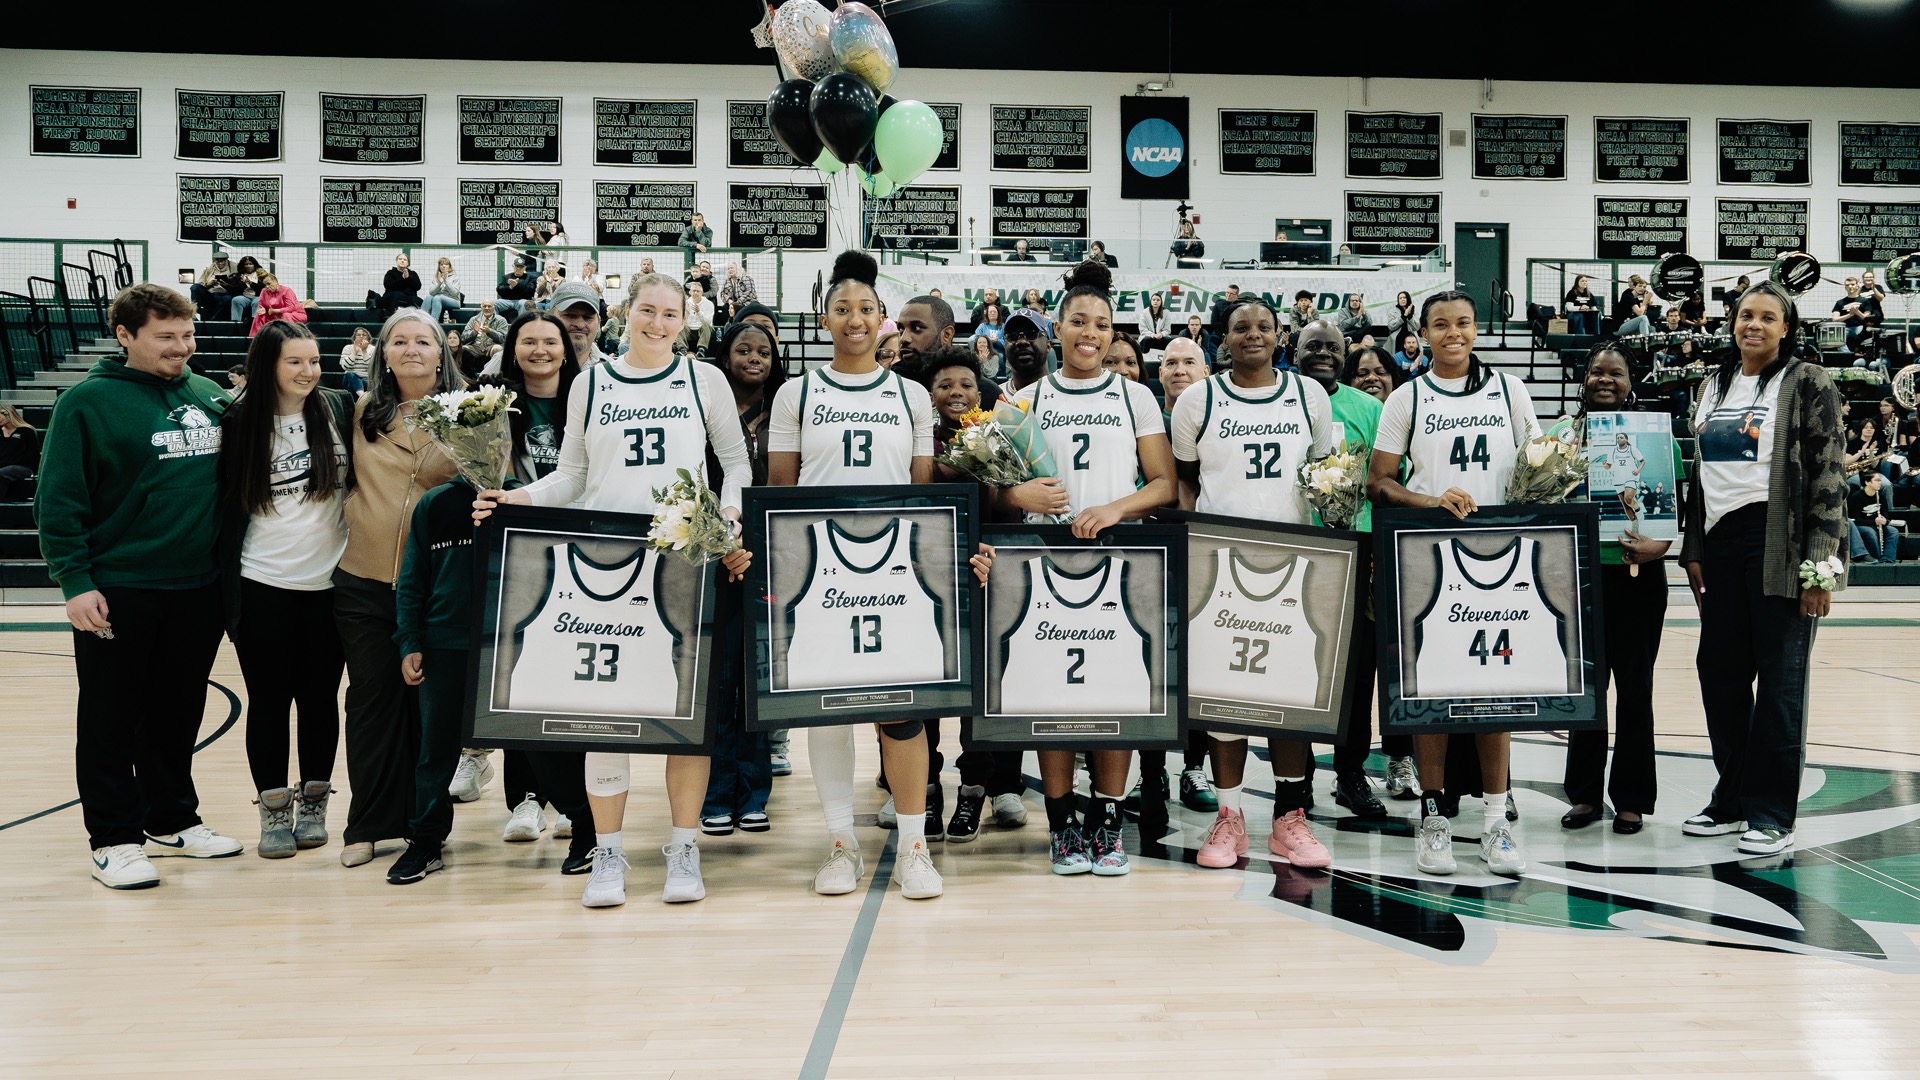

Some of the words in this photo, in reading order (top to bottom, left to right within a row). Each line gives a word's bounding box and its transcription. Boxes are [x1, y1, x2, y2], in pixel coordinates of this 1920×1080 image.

[93, 92, 137, 103] SOCCER
[33, 103, 66, 113] NCAA
[69, 103, 120, 115] DIVISION
[123, 105, 136, 115] III
[499, 101, 557, 111] LACROSSE
[635, 104, 693, 114] LACROSSE
[461, 113, 491, 123] NCAA
[493, 113, 543, 124] DIVISION
[546, 113, 558, 124] III
[994, 109, 1026, 119] MEN'S
[1031, 110, 1087, 120] LACROSSE
[36, 115, 134, 128] CHAMPIONSHIPS
[597, 115, 626, 125] NCAA
[629, 115, 679, 126] DIVISION
[680, 116, 693, 126] III
[1272, 116, 1300, 127] GOLF
[464, 125, 556, 136] CHAMPIONSHIPS
[994, 121, 1022, 131] NCAA
[1026, 121, 1073, 132] DIVISION
[1076, 122, 1087, 132] III
[42, 128, 80, 139] FIRST
[86, 129, 127, 140] ROUND
[599, 127, 690, 138] CHAMPIONSHIPS
[997, 132, 1084, 144] CHAMPIONSHIPS
[1222, 130, 1251, 140] NCAA
[1253, 131, 1300, 142] DIVISION
[1302, 132, 1313, 142] III
[70, 141, 100, 152] 2010
[475, 137, 544, 147] SEMIFINALS
[598, 139, 691, 151] QUARTERFINALS
[495, 150, 524, 160] 2012
[994, 144, 1087, 155] QUARTERFINALS
[1132, 146, 1182, 162] NCAA
[1224, 144, 1311, 155] CHAMPIONSHIPS
[633, 152, 658, 163] 2011
[1028, 157, 1054, 167] 2014
[1256, 157, 1280, 168] 2013
[180, 178, 230, 190] WOMEN'S
[237, 180, 279, 190] SOCCER
[324, 182, 360, 191] WOMEN'S
[366, 183, 421, 191] BASKETBALL
[635, 185, 692, 195] LACROSSE
[748, 188, 808, 198] FOOTBALL
[180, 191, 212, 202] NCAA
[214, 192, 264, 202] DIVISION
[267, 192, 279, 202] III
[323, 192, 354, 203] NCAA
[356, 192, 407, 203] DIVISION
[409, 193, 422, 203] III
[596, 197, 627, 207] NCAA
[630, 197, 679, 208] DIVISION
[681, 198, 694, 208] III
[730, 199, 760, 210] NCAA
[763, 199, 813, 210] DIVISION
[815, 200, 827, 210] III
[1354, 197, 1400, 208] WOMEN'S
[1406, 198, 1433, 208] GOLF
[1603, 202, 1649, 212] WOMEN'S
[1655, 203, 1682, 213] GOLF
[183, 204, 277, 214] CHAMPIONSHIPS
[325, 204, 419, 216] CHAMPIONSHIPS
[599, 209, 691, 220] CHAMPIONSHIPS
[184, 216, 231, 227] SECOND
[235, 216, 275, 227] ROUND
[327, 216, 372, 227] SECOND
[378, 217, 418, 227] ROUND
[734, 211, 824, 222] CHAMPIONSHIPS
[1348, 212, 1376, 222] NCAA
[1378, 212, 1425, 223] DIVISION
[1598, 216, 1625, 227] NCAA
[1628, 217, 1673, 227] DIVISION
[1676, 217, 1687, 227] III
[1719, 212, 1746, 222] NCAA
[1747, 213, 1794, 223] DIVISION
[1796, 213, 1807, 224] III
[606, 222, 642, 232] FIRST
[647, 222, 685, 233] ROUND
[740, 224, 774, 234] FIRST
[777, 224, 817, 235] ROUND
[1353, 227, 1434, 238] CHAMPIONSHIP
[1720, 224, 1805, 235] CHAMPIONSHIPS
[217, 229, 244, 239] 2014
[358, 229, 386, 239] 2015
[631, 234, 659, 245] 2016
[1603, 230, 1683, 241] CHAMPIONSHIP
[764, 236, 792, 246] 2016
[1726, 236, 1758, 246] FIRST
[1763, 236, 1800, 247] ROUND
[1631, 245, 1656, 255] 2015
[1751, 248, 1776, 258] 2015
[599, 402, 690, 426] Stevenson
[812, 404, 900, 427] Stevenson
[1041, 410, 1122, 430] Stevenson
[1424, 412, 1506, 434] Stevenson
[1219, 418, 1300, 438] Stevenson
[624, 427, 666, 467] 33
[842, 429, 872, 467] 13
[1072, 433, 1089, 471] 2
[1449, 433, 1491, 471] 44
[159, 451, 193, 460] WOMEN'S
[1243, 442, 1282, 479] 32
[271, 486, 299, 496] OMEN'S
[822, 587, 907, 609] Stevenson
[1448, 602, 1530, 624] Stevenson
[554, 612, 646, 638] Stevenson
[1214, 609, 1293, 636] Stevenson
[850, 614, 882, 654] 13
[1035, 620, 1117, 641] Stevenson
[1468, 629, 1512, 665] 44
[1229, 636, 1270, 674] 32
[574, 642, 620, 682] 33
[1066, 648, 1085, 684] 2
